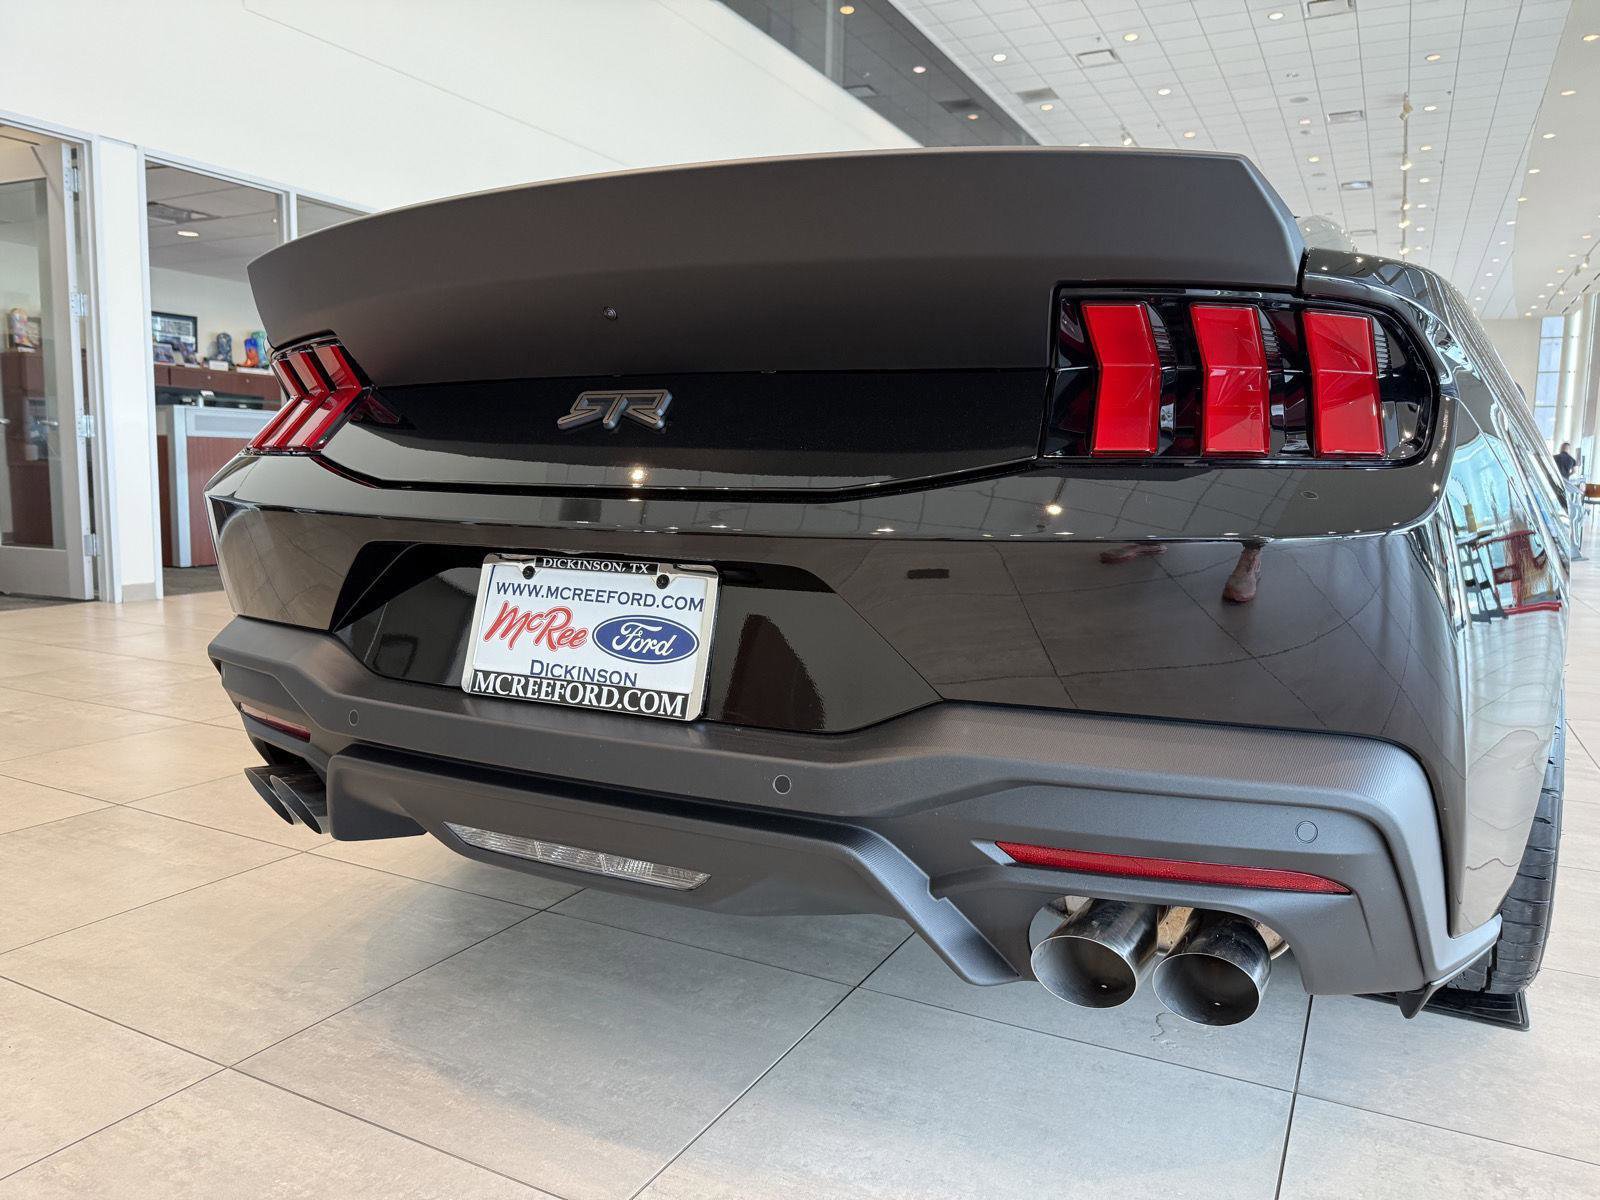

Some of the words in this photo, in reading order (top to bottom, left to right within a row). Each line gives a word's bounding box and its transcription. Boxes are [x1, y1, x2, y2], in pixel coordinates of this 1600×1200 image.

[542, 558, 626, 573] DICKINSON,
[629, 561, 649, 574] TX
[496, 581, 705, 612] WWW.MCREEFORD.COM
[483, 600, 589, 651] McRee
[611, 621, 677, 657] Ford
[530, 659, 638, 687] DICKINSON
[473, 671, 685, 717] MCREEFORD.COM
